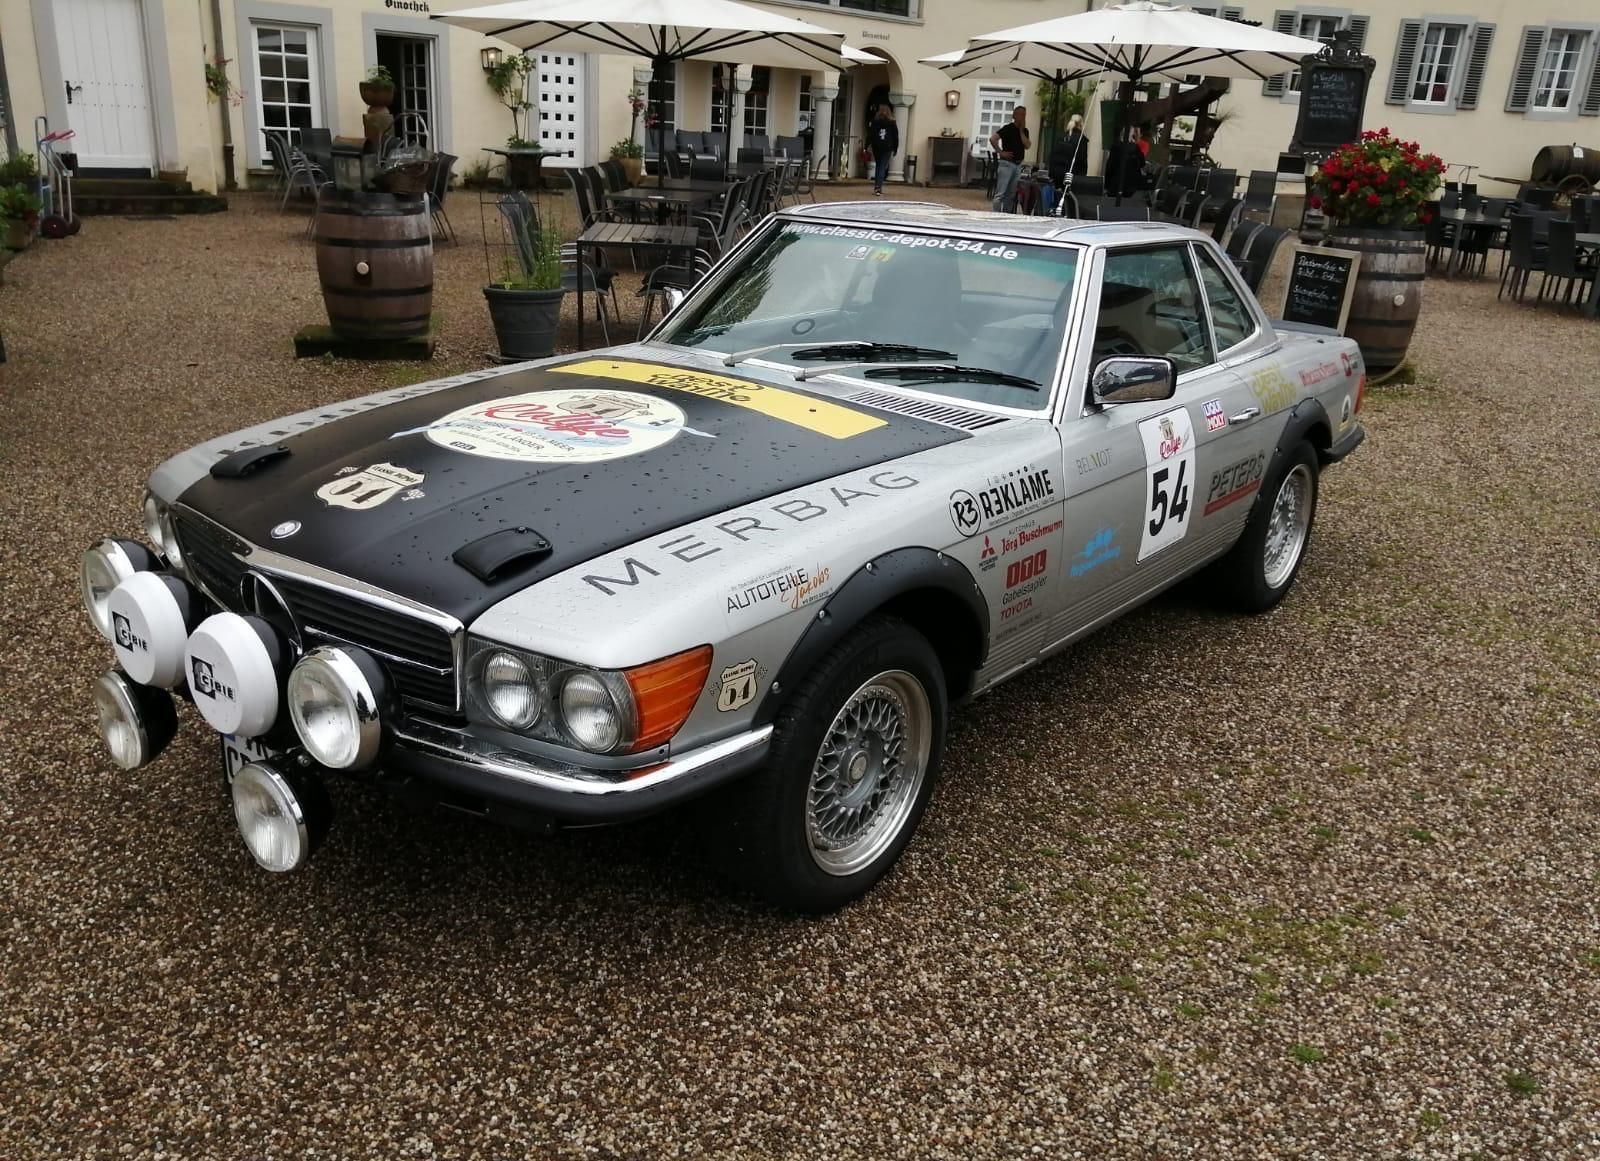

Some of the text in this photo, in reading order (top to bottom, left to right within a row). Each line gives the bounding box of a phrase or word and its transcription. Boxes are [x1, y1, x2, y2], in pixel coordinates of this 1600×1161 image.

[781, 222, 1018, 260] www.classic-depot-54.de
[1206, 414, 1225, 431] MOLY
[1075, 448, 1112, 475] BELMOT
[1209, 453, 1265, 502] PETERS
[1149, 459, 1189, 536] 54
[581, 471, 920, 597] MERBAG
[1001, 519, 1063, 555] Jörg Buschmann
[1006, 549, 1047, 589] ITL
[727, 567, 809, 613] AUTOTEILE
[1000, 597, 1033, 620] TOYOTA
[1002, 576, 1048, 605] Gabelstapler
[724, 676, 751, 706] 54
